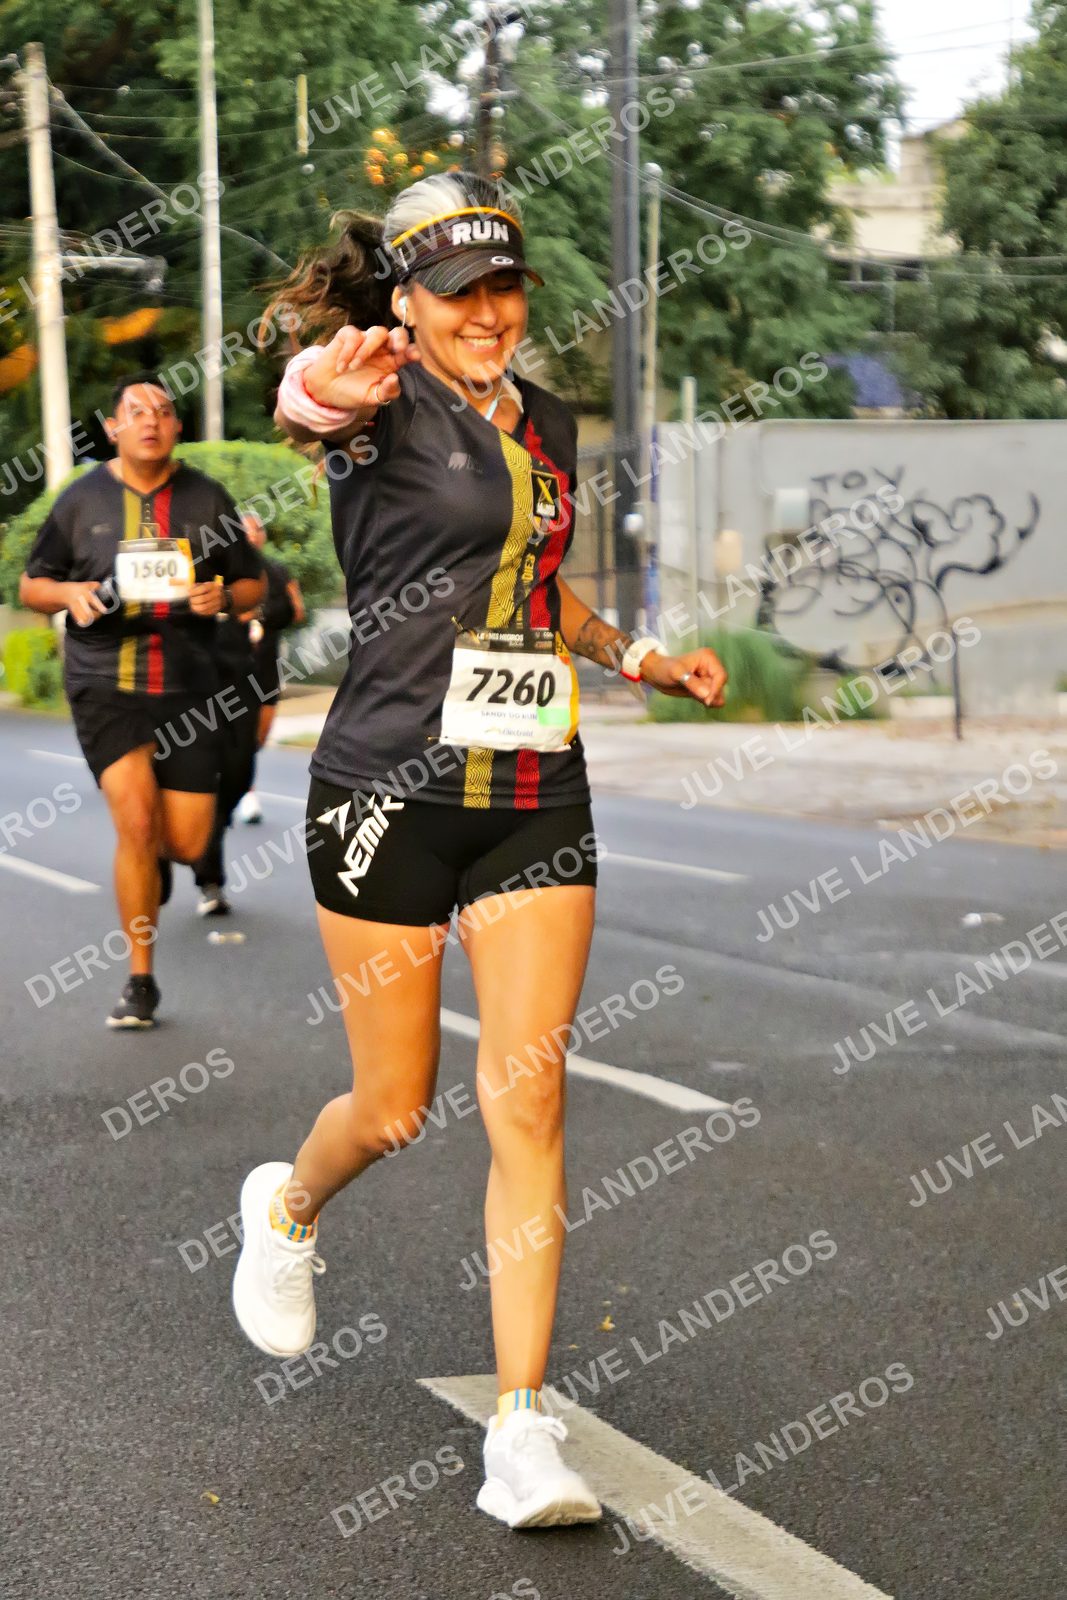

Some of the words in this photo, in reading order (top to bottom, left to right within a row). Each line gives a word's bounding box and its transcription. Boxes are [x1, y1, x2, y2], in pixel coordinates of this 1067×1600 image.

[452, 220, 510, 246] RUN
[811, 465, 905, 493] TOY
[131, 559, 178, 578] 1560
[466, 667, 556, 707] 7260
